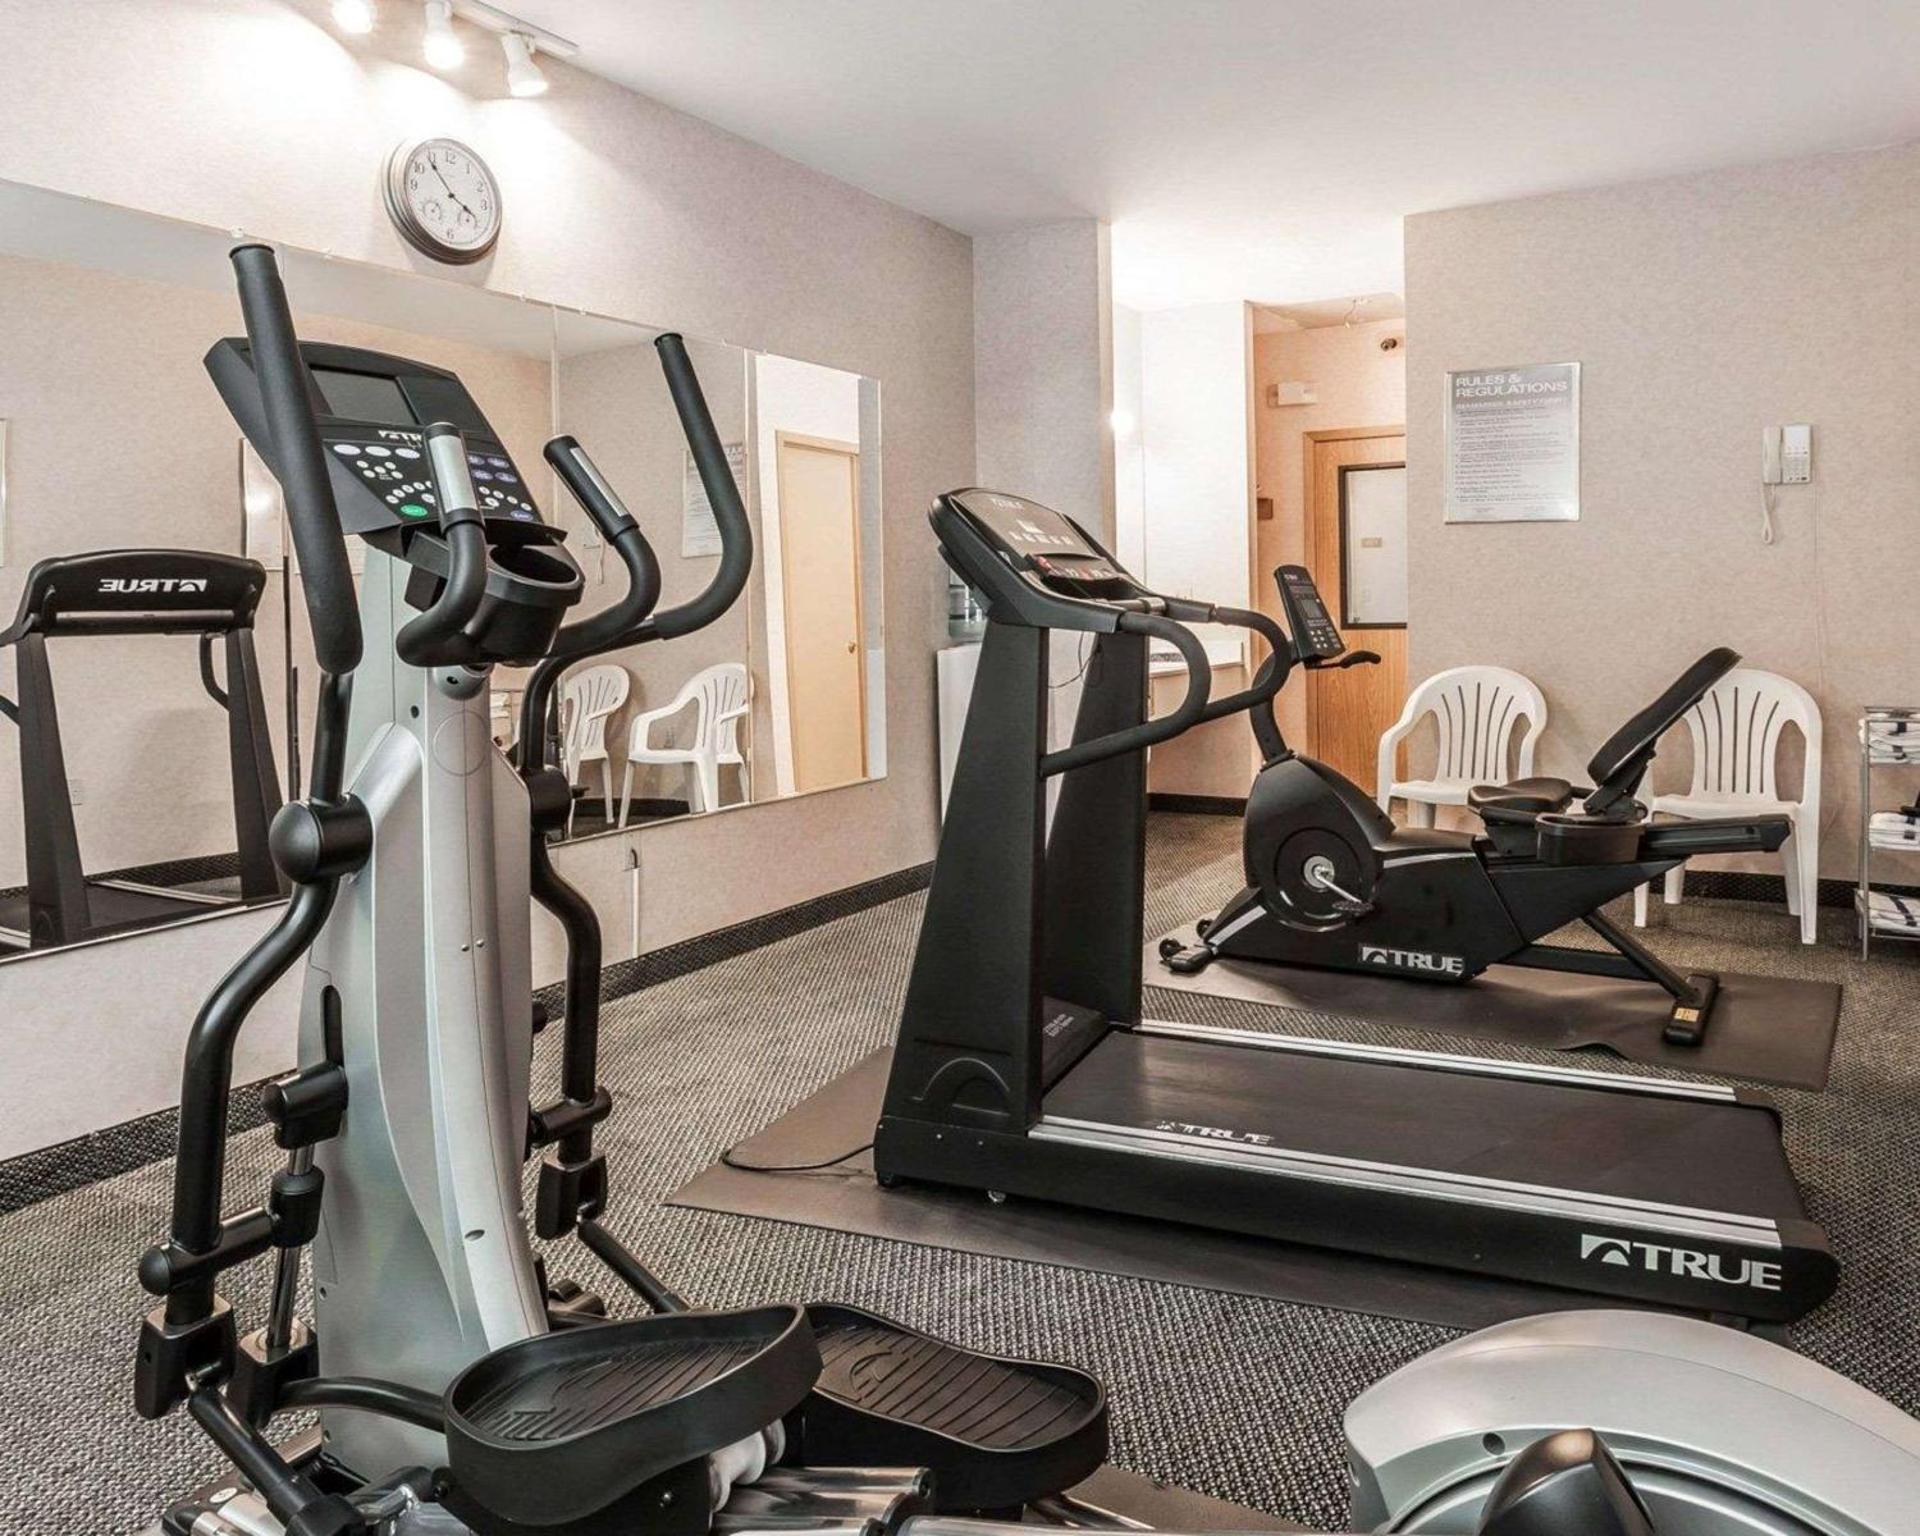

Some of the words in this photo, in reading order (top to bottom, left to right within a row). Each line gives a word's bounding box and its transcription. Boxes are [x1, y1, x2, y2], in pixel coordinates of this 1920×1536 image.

[1456, 375, 1505, 387] RULES
[1508, 373, 1522, 384] &
[1456, 382, 1568, 397] REGULATIONS
[1388, 950, 1464, 974] TRUE
[1179, 1123, 1274, 1145] TRUE
[1632, 1241, 1782, 1291] TRUE
